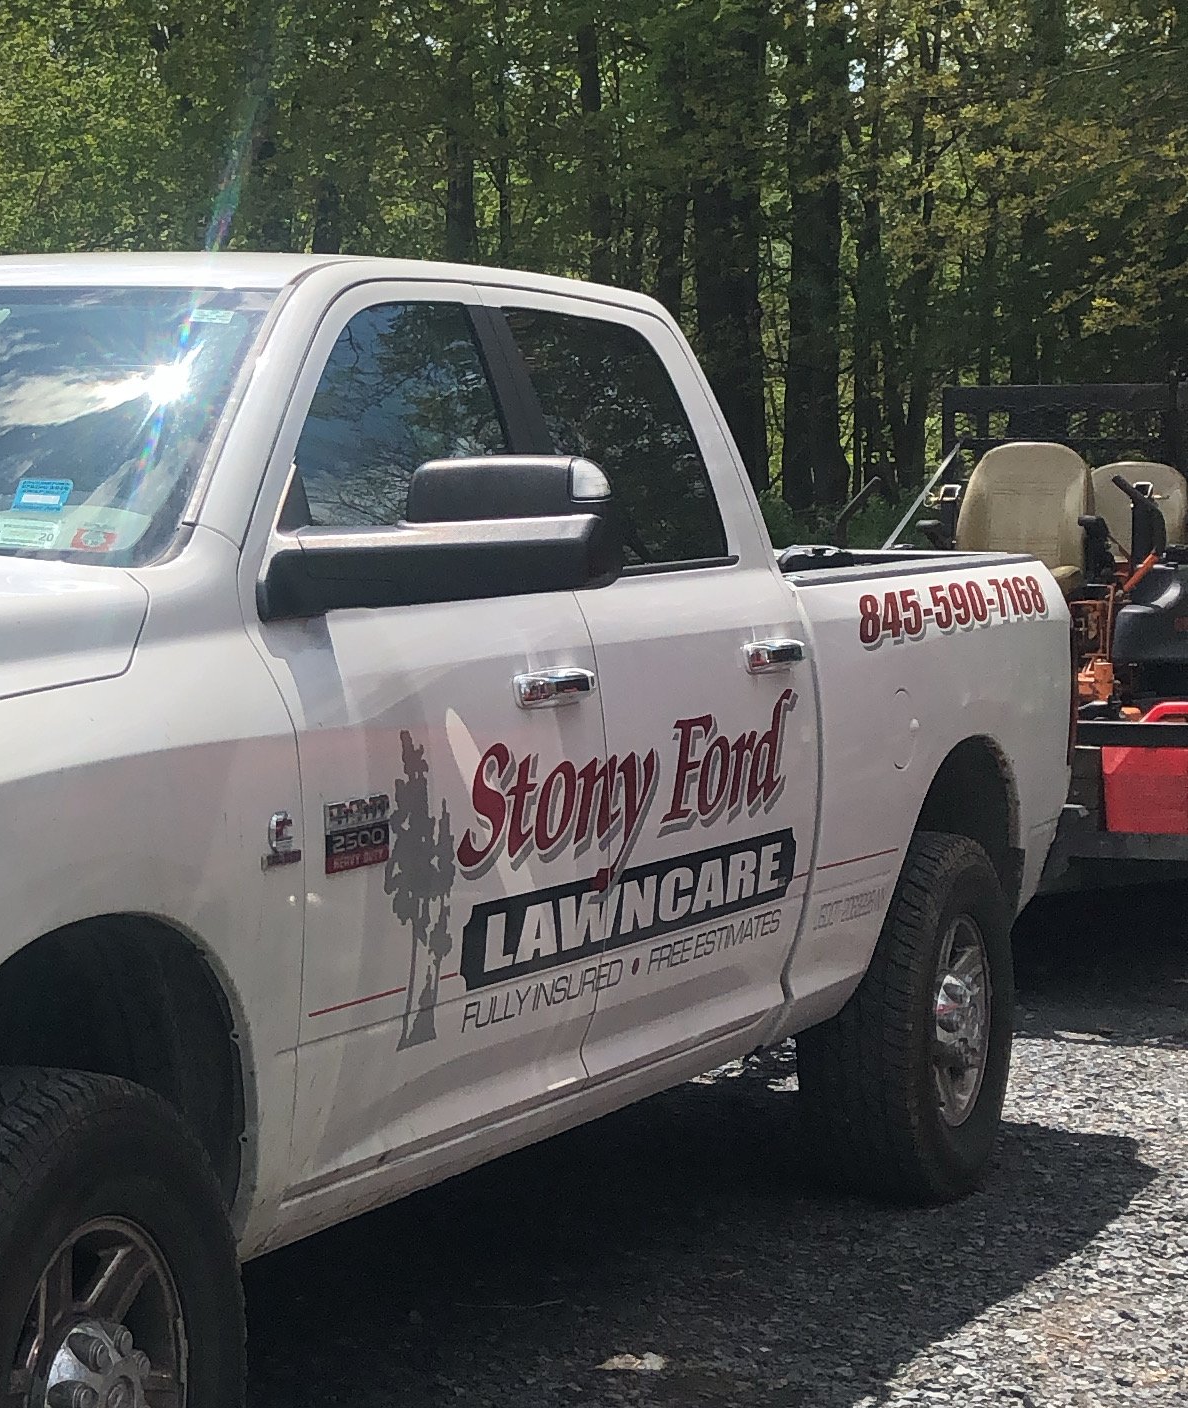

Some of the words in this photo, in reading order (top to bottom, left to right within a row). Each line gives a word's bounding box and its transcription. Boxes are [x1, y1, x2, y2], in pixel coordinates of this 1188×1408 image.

[38, 532, 54, 542] 20
[859, 575, 1048, 650] 845-590-7168
[333, 827, 385, 854] 2500
[457, 742, 657, 900] Stony
[660, 689, 796, 834] Ford
[483, 842, 782, 973] LAWNCARE
[461, 985, 531, 1033] FULLY
[530, 959, 624, 1012] INSURED
[646, 939, 694, 975] FREE
[692, 909, 782, 959] ESTIMATES
